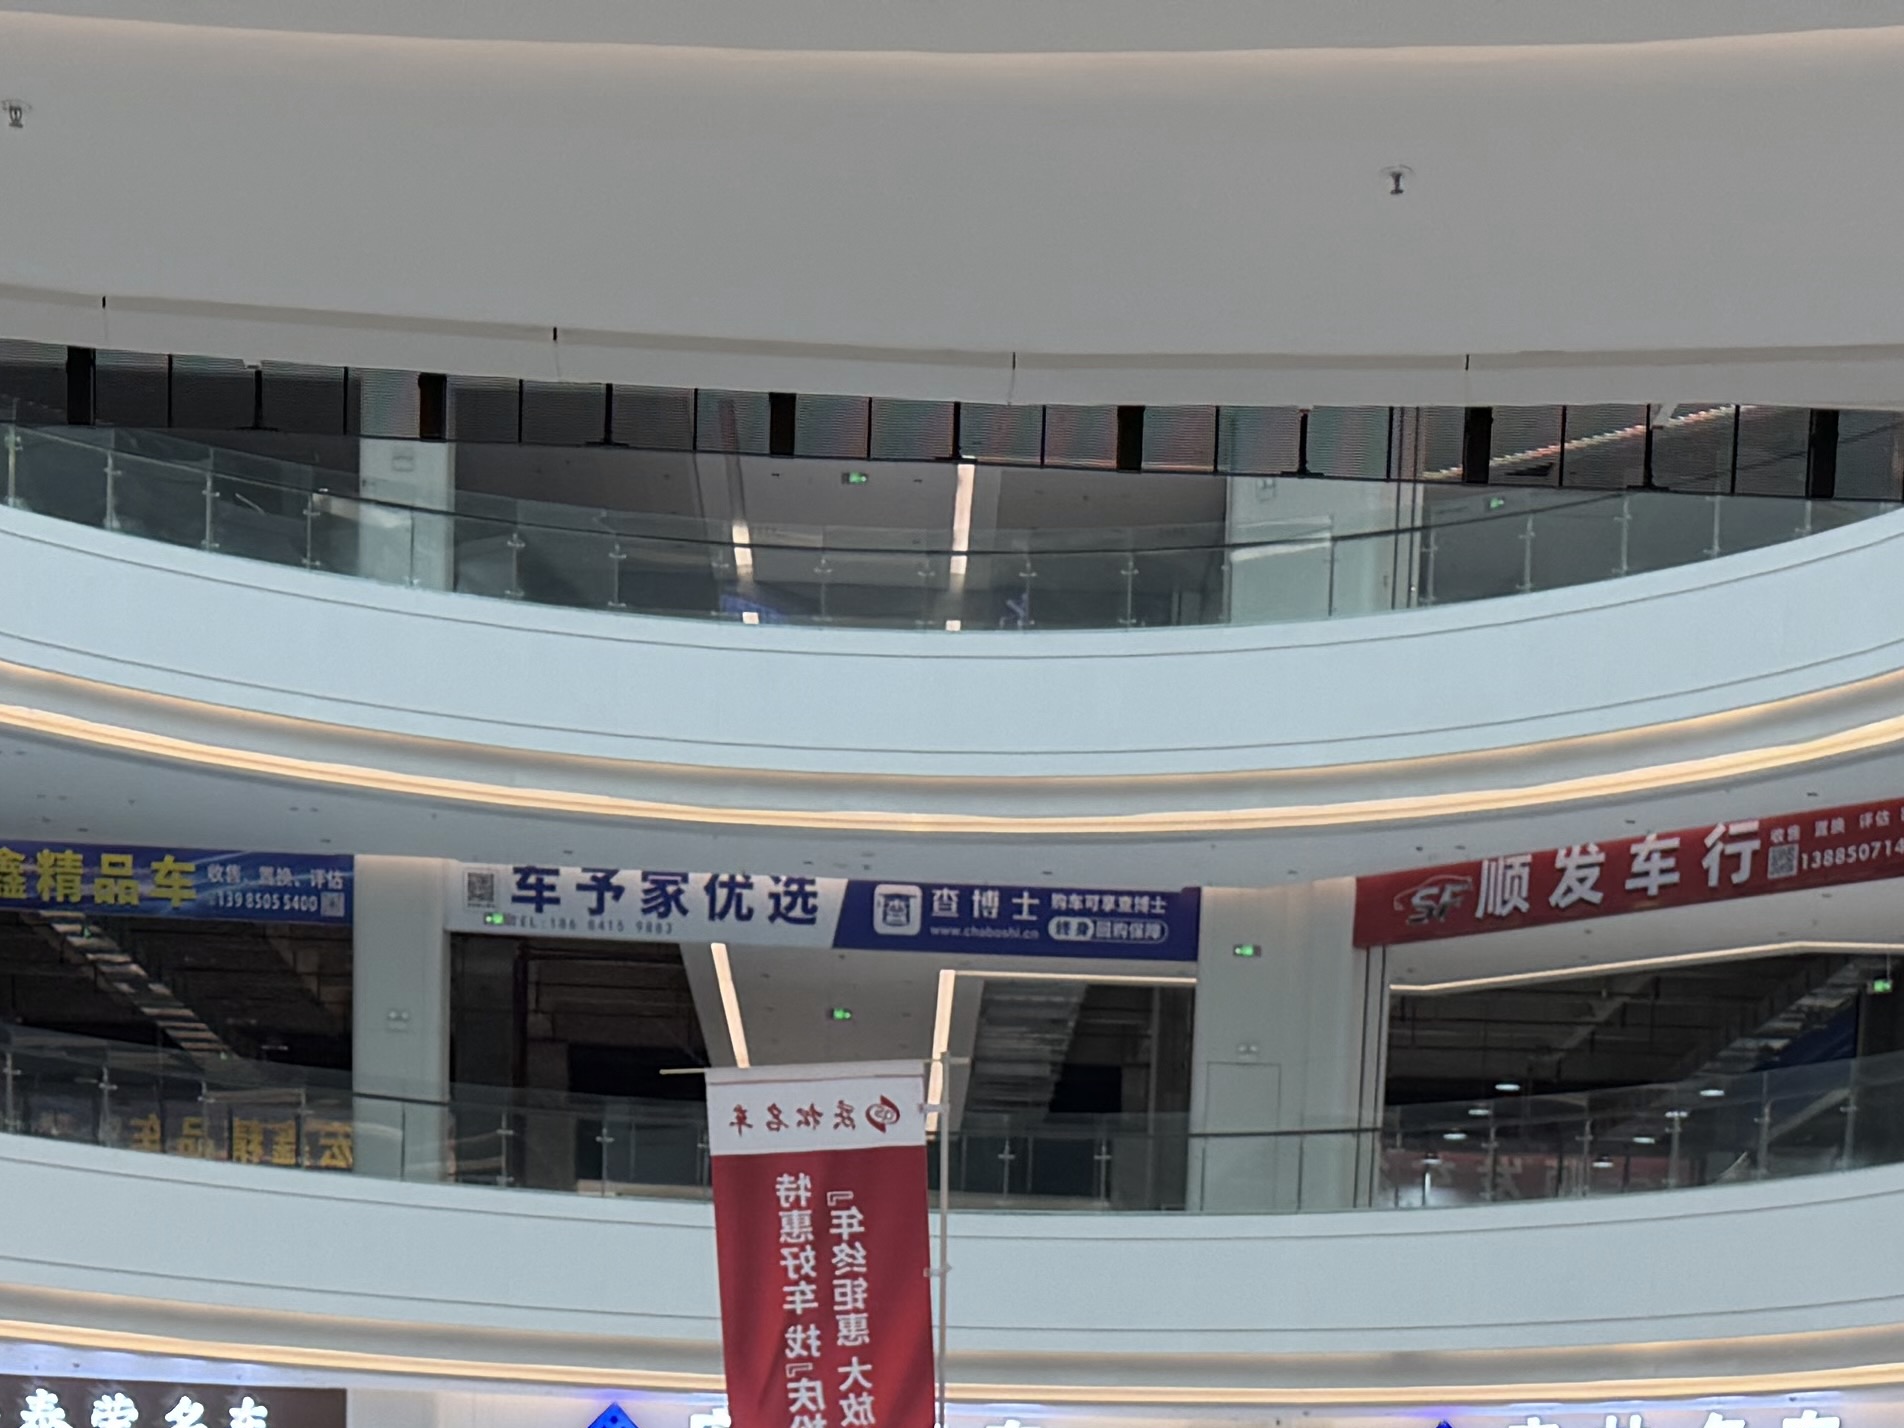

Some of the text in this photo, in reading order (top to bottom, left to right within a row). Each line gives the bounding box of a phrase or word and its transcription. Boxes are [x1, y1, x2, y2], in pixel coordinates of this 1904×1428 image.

[510, 864, 819, 926] 车予家优选
[1475, 820, 1762, 920] 顺发车行
[930, 887, 1041, 921] 查博士
